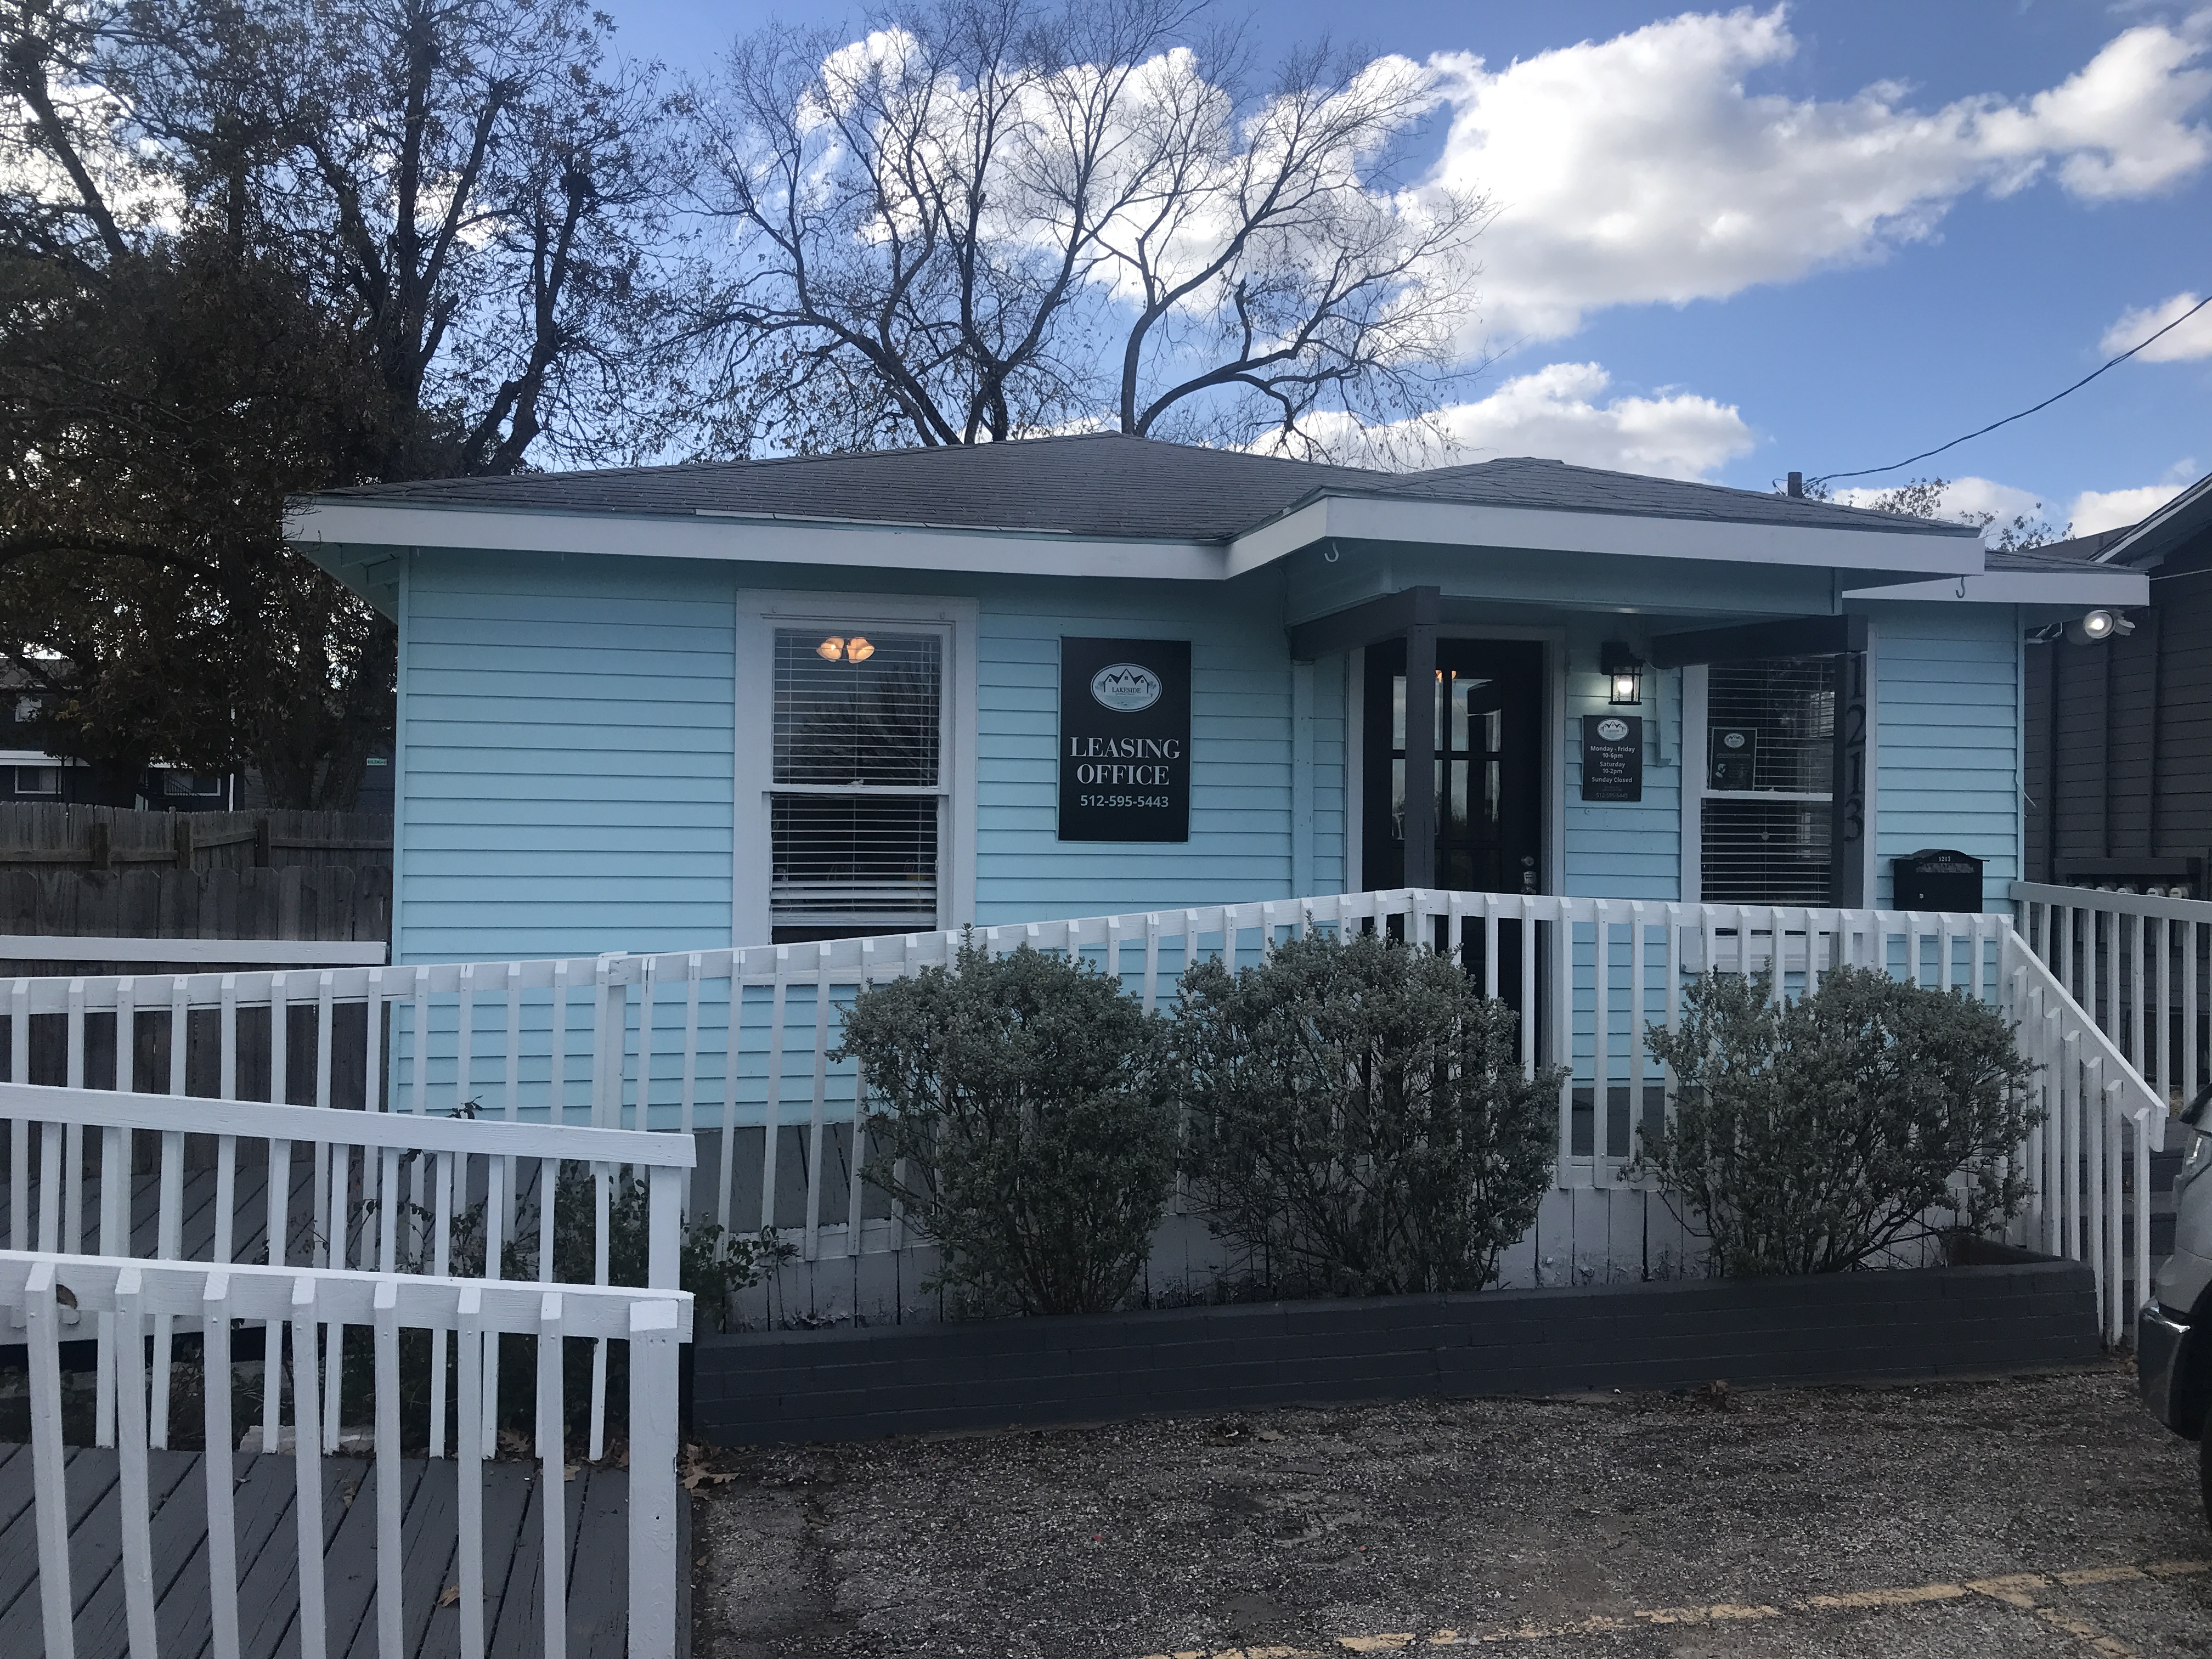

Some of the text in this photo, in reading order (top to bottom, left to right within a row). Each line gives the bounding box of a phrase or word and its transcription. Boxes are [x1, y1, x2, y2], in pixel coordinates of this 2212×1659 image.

[1070, 737, 1181, 759] LEASING
[1077, 764, 1170, 785] OFFICE
[1080, 795, 1169, 808] 512-595-5443
